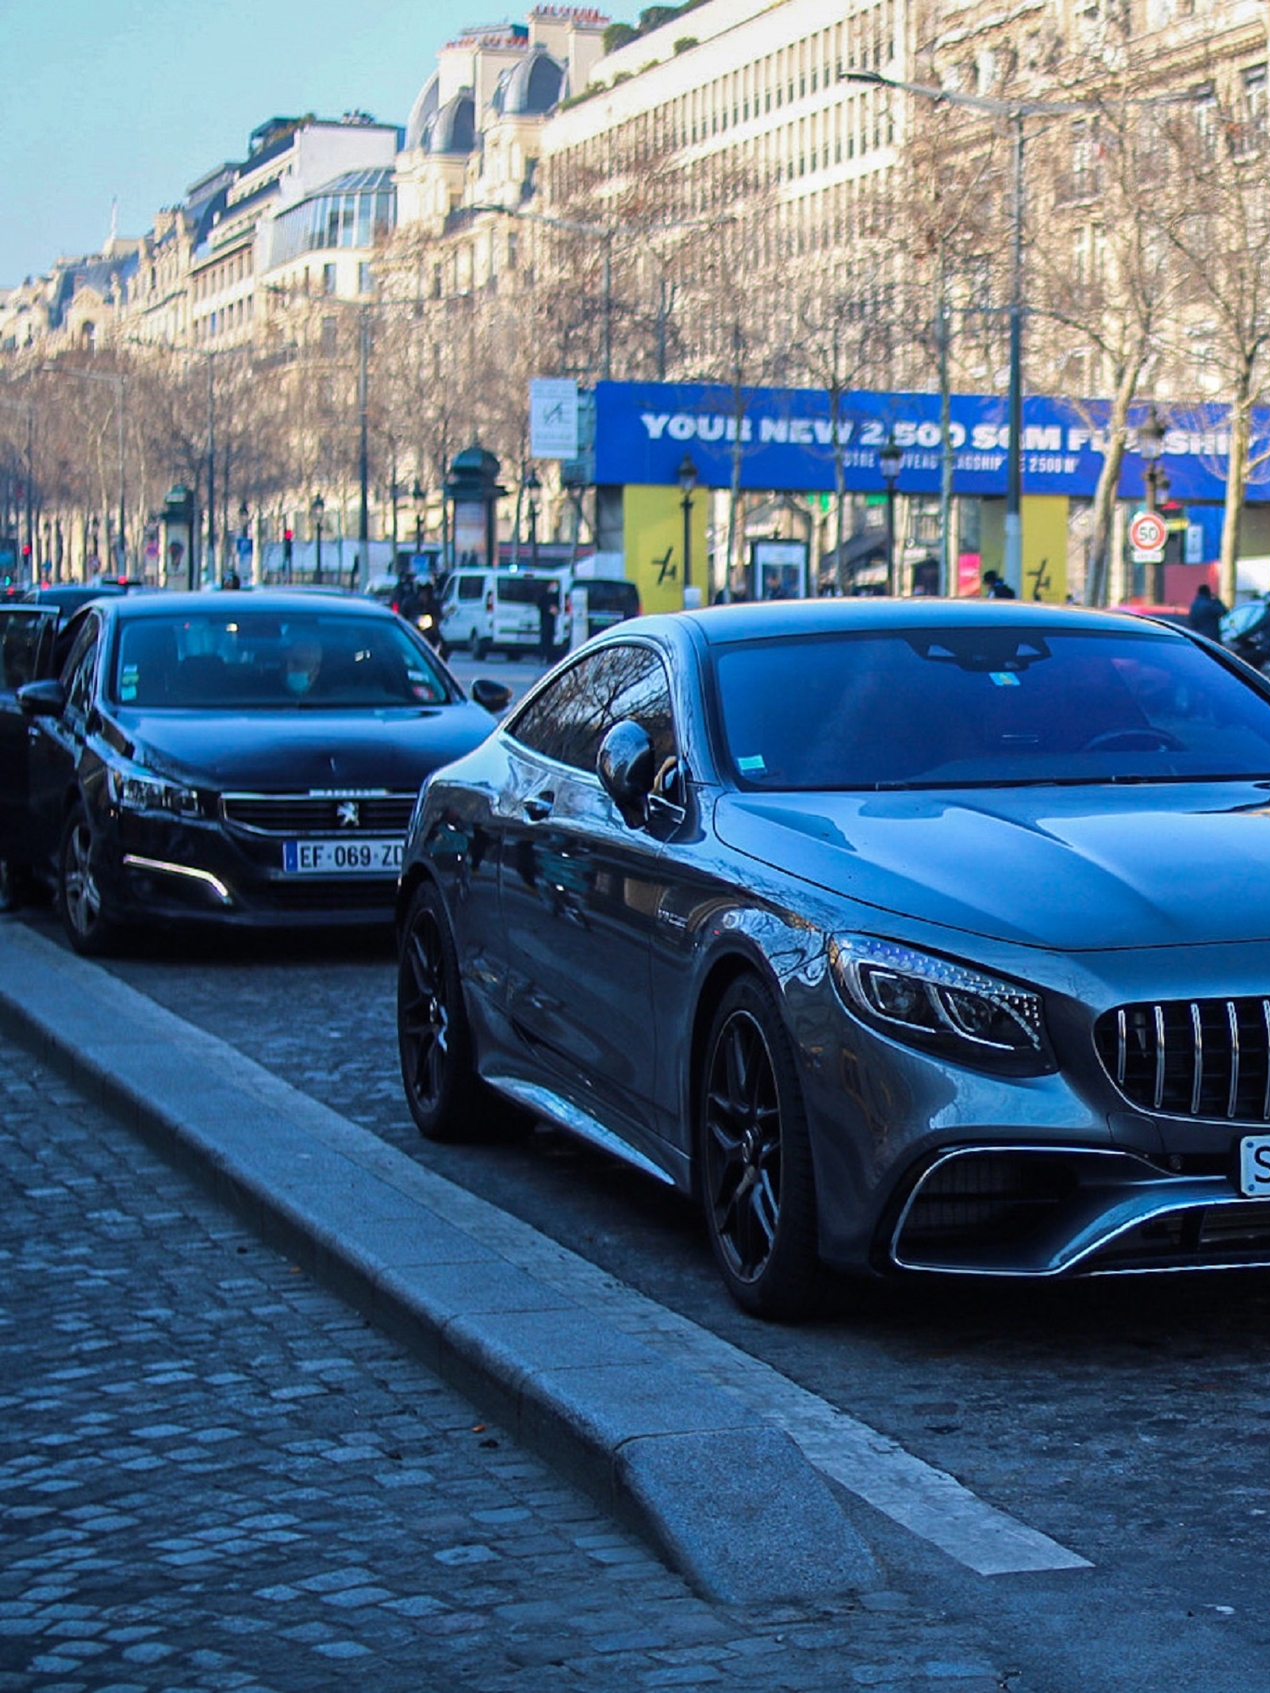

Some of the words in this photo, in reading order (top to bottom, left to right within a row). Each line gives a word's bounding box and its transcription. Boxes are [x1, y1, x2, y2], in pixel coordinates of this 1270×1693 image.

[641, 412, 752, 441] YOUR
[759, 417, 854, 445] NEW
[1068, 429, 1258, 455] FLSHI
[841, 453, 875, 468] OTRE
[1030, 456, 1062, 473] 2500
[1138, 525, 1158, 541] 50
